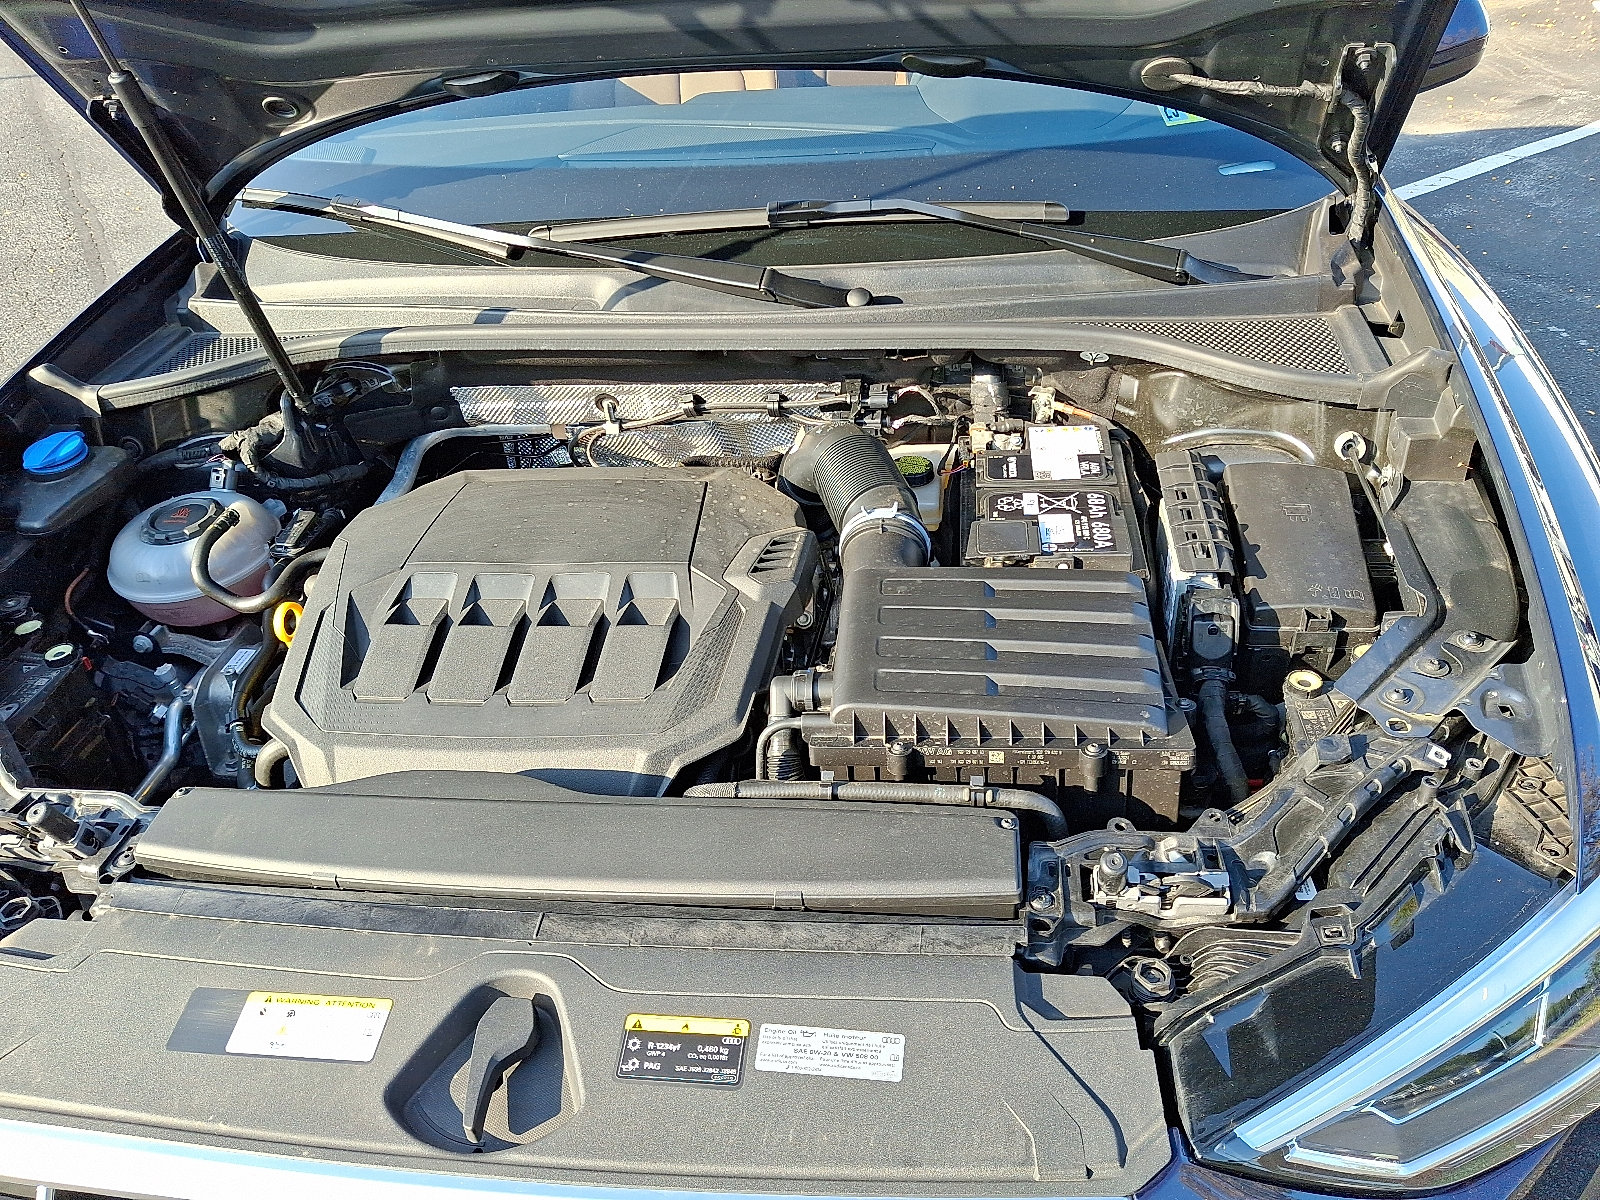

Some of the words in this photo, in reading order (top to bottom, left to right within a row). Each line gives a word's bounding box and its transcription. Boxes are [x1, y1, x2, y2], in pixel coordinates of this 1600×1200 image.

[1086, 493, 1108, 519] 68Ah
[1090, 521, 1114, 549] 680A
[276, 996, 320, 1006] WARNING
[325, 999, 376, 1009] ATTENTION
[764, 1027, 785, 1035] Engine
[719, 1045, 729, 1055] kg
[643, 1061, 661, 1071] PAG
